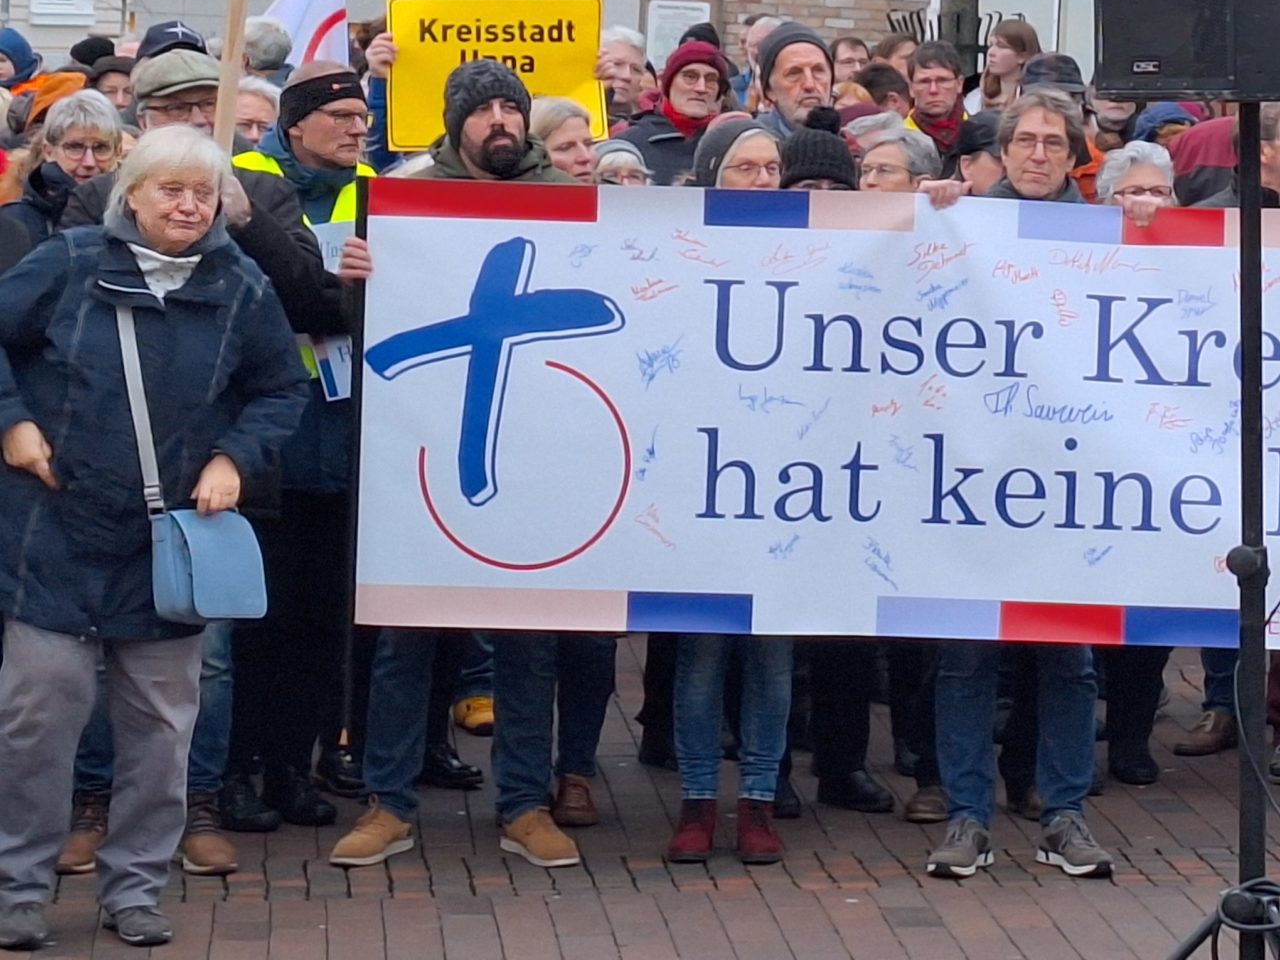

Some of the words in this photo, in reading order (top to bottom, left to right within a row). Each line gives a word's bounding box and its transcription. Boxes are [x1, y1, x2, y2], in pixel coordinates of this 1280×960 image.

[419, 18, 576, 43] Kreisstadt
[703, 278, 1044, 378] Unser
[695, 427, 882, 523] hat
[921, 433, 1223, 535] keine
